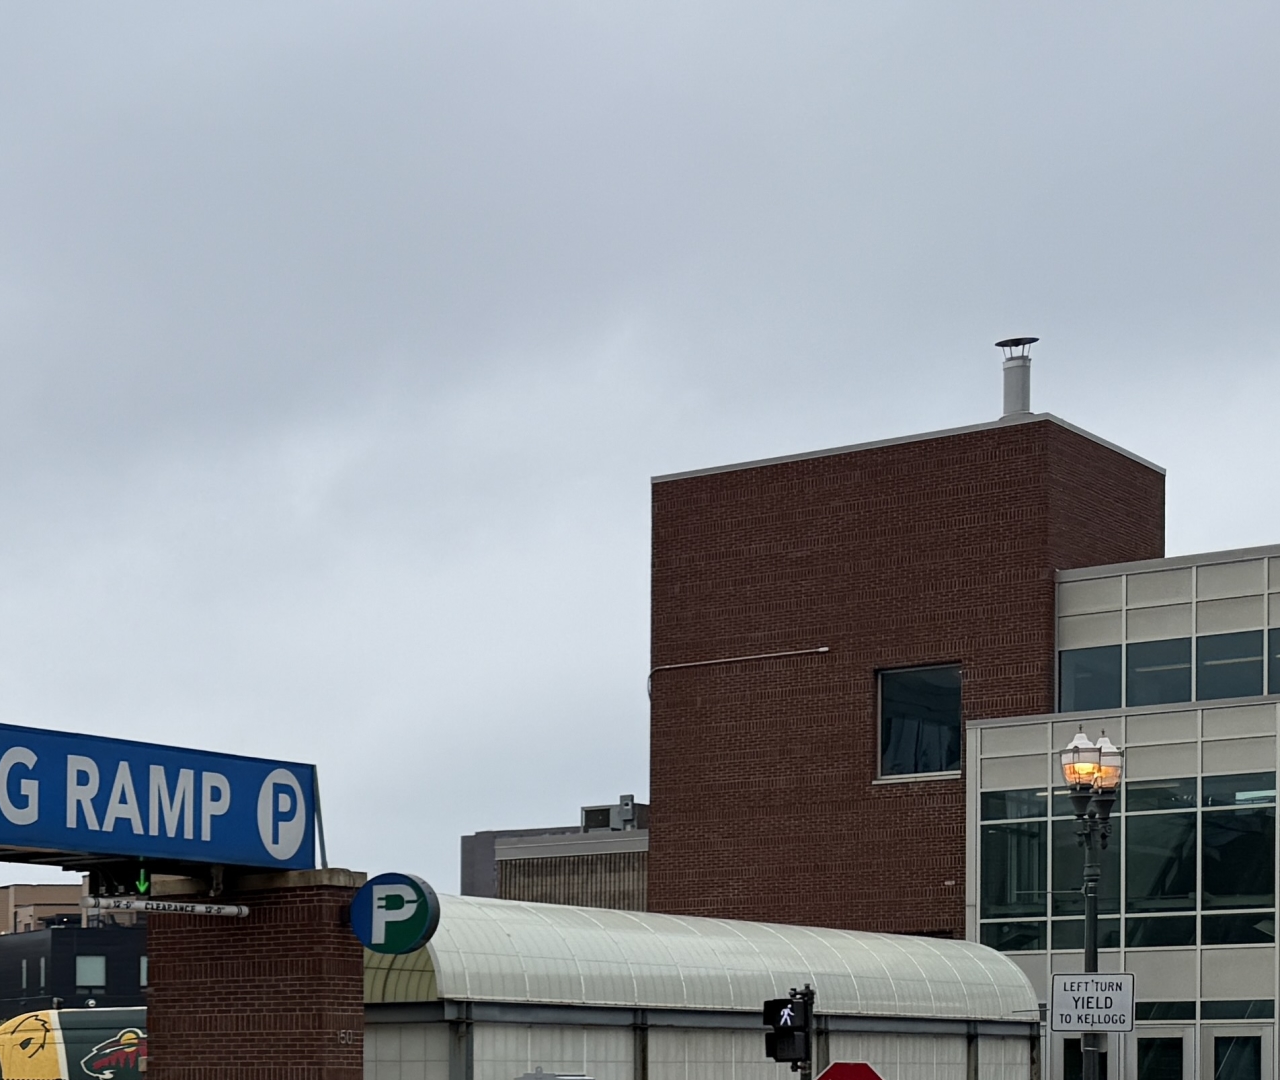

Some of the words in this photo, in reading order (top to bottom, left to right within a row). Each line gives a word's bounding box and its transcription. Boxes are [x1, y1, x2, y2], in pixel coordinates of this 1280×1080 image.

[66, 754, 231, 842] RAMP
[272, 782, 298, 846] P
[145, 902, 196, 913] CLEARANCE
[371, 884, 417, 944] P
[1063, 981, 1089, 992] LEFT
[1095, 981, 1123, 992] TURN
[1072, 996, 1113, 1010] YIELD
[1059, 1013, 1072, 1024] TO
[1077, 1013, 1126, 1025] KELLOGG
